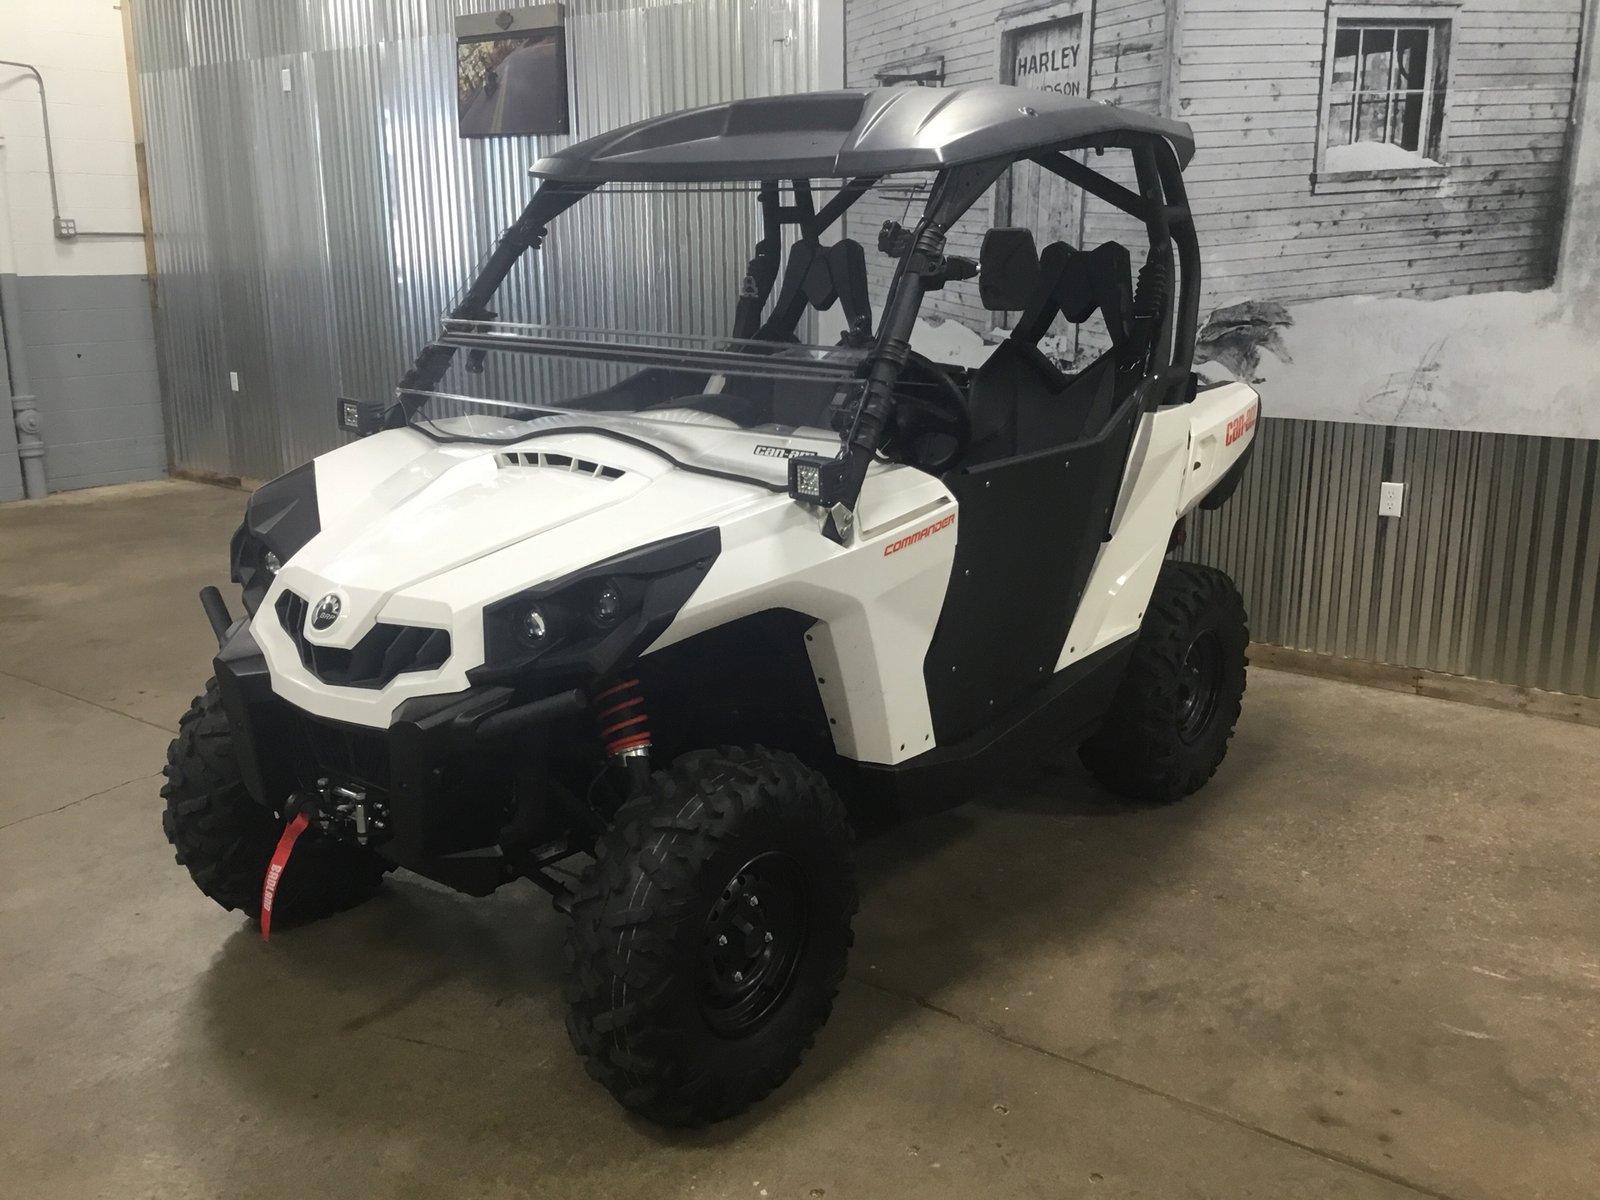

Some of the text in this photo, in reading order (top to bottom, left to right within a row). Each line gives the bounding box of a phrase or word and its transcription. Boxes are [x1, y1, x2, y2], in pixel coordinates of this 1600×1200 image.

[1018, 44, 1080, 76] HARLEY
[1036, 81, 1080, 97] DSON
[884, 513, 956, 557] COMMANDER
[319, 612, 336, 620] BRP
[263, 863, 283, 912] BADLAND
